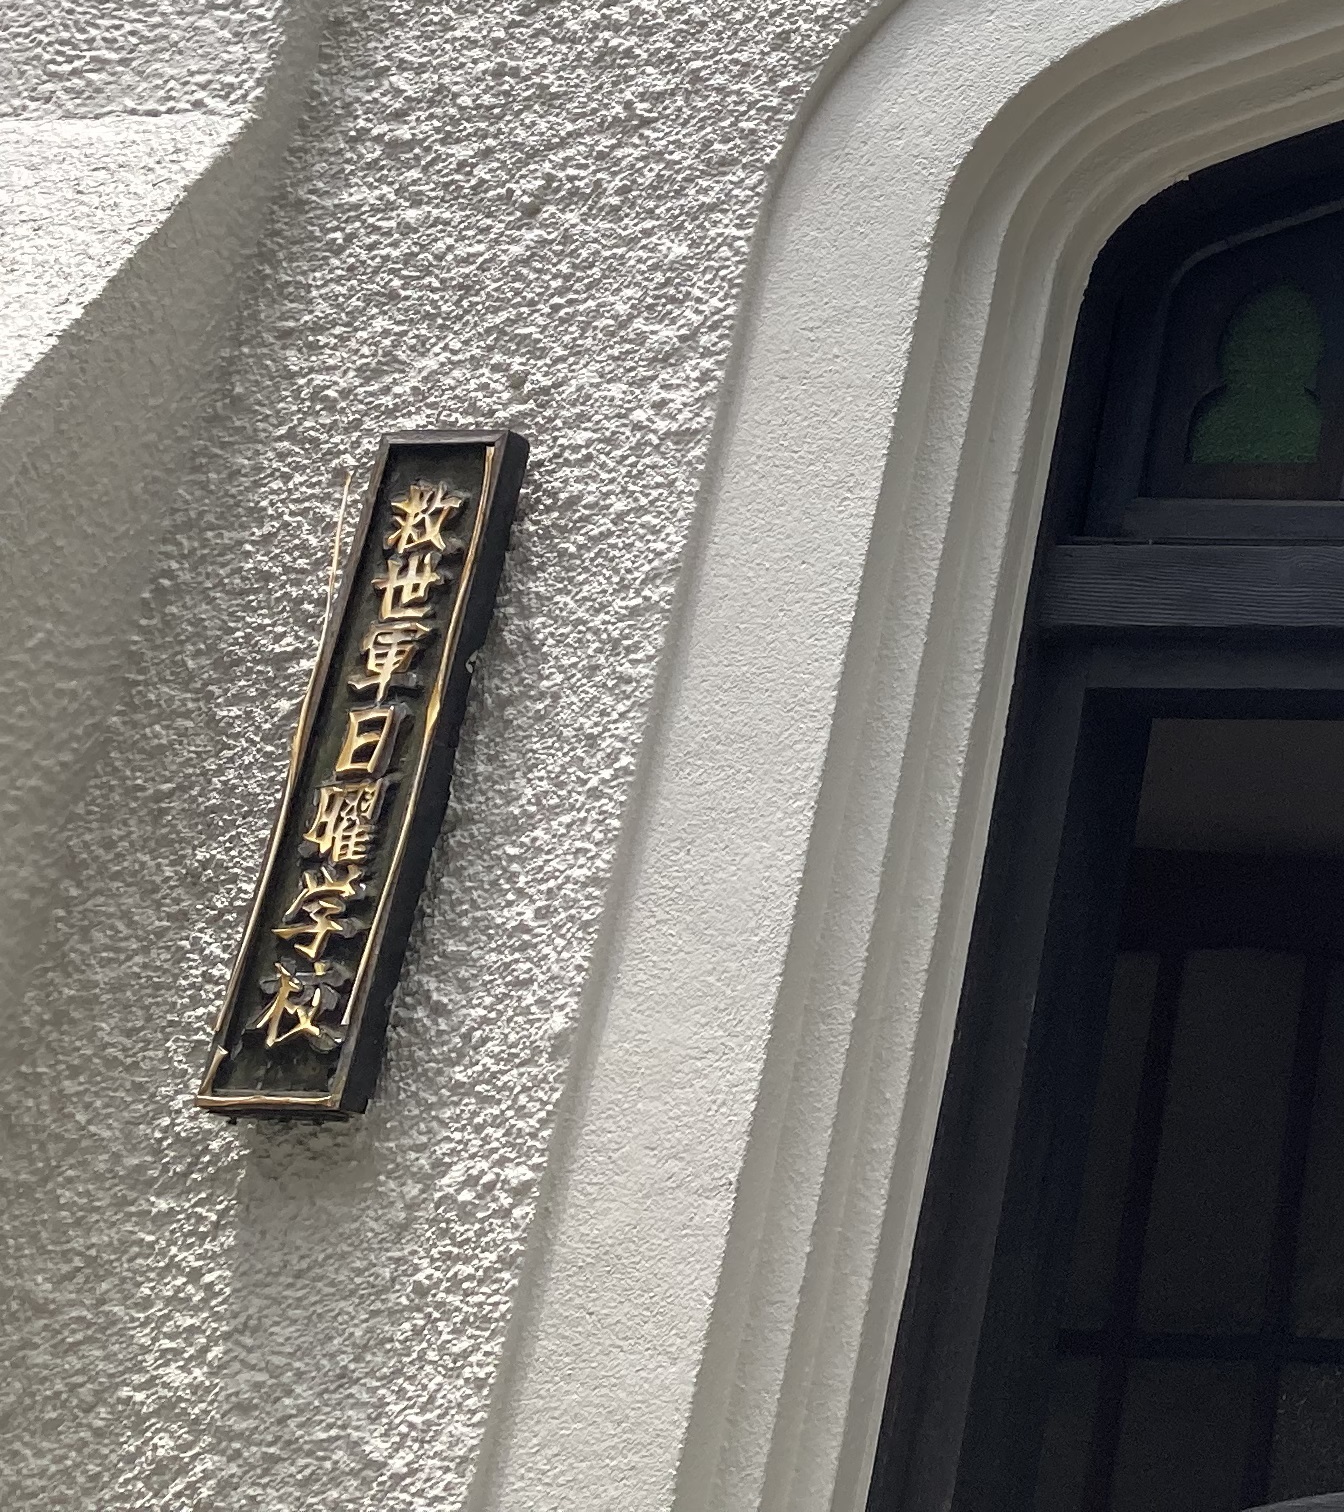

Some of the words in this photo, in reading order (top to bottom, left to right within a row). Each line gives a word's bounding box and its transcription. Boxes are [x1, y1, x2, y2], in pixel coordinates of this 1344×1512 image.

[257, 484, 463, 1048] 救世軍日曜学校
